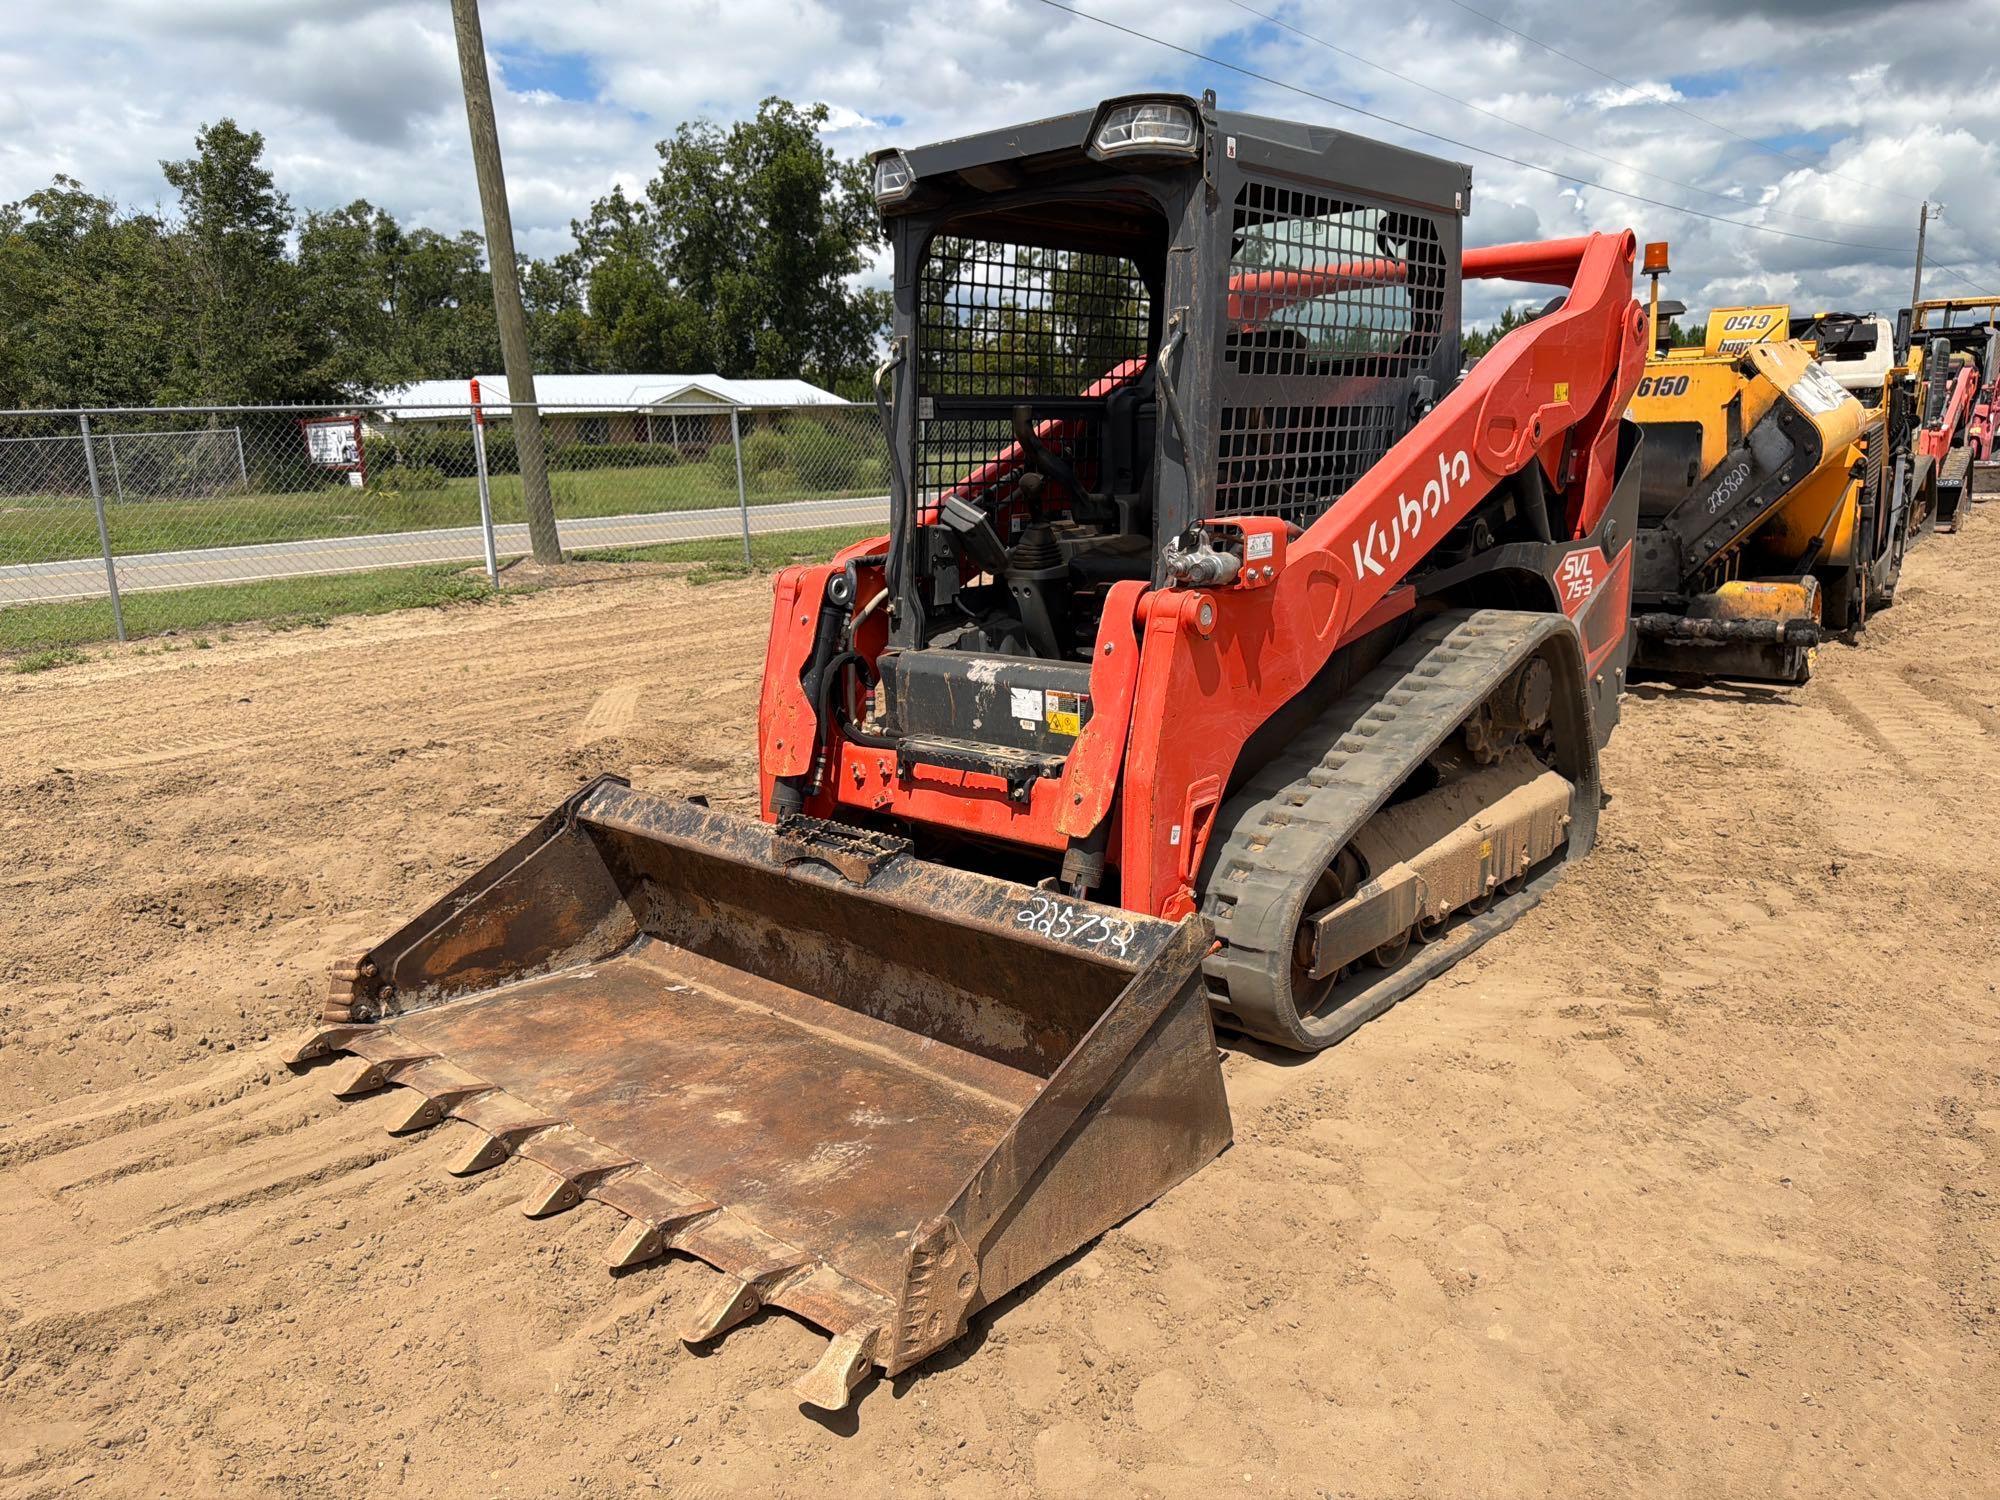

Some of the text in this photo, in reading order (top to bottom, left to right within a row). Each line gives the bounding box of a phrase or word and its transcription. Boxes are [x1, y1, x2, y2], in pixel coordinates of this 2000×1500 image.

[1724, 314, 1771, 331] 6150
[1636, 375, 1690, 397] 6150
[1707, 463, 1750, 514] 225820
[1352, 450, 1471, 580] Kubota
[1562, 554, 1593, 581] SVL
[1566, 577, 1593, 600] 75-3
[1017, 897, 1135, 957] 225752
